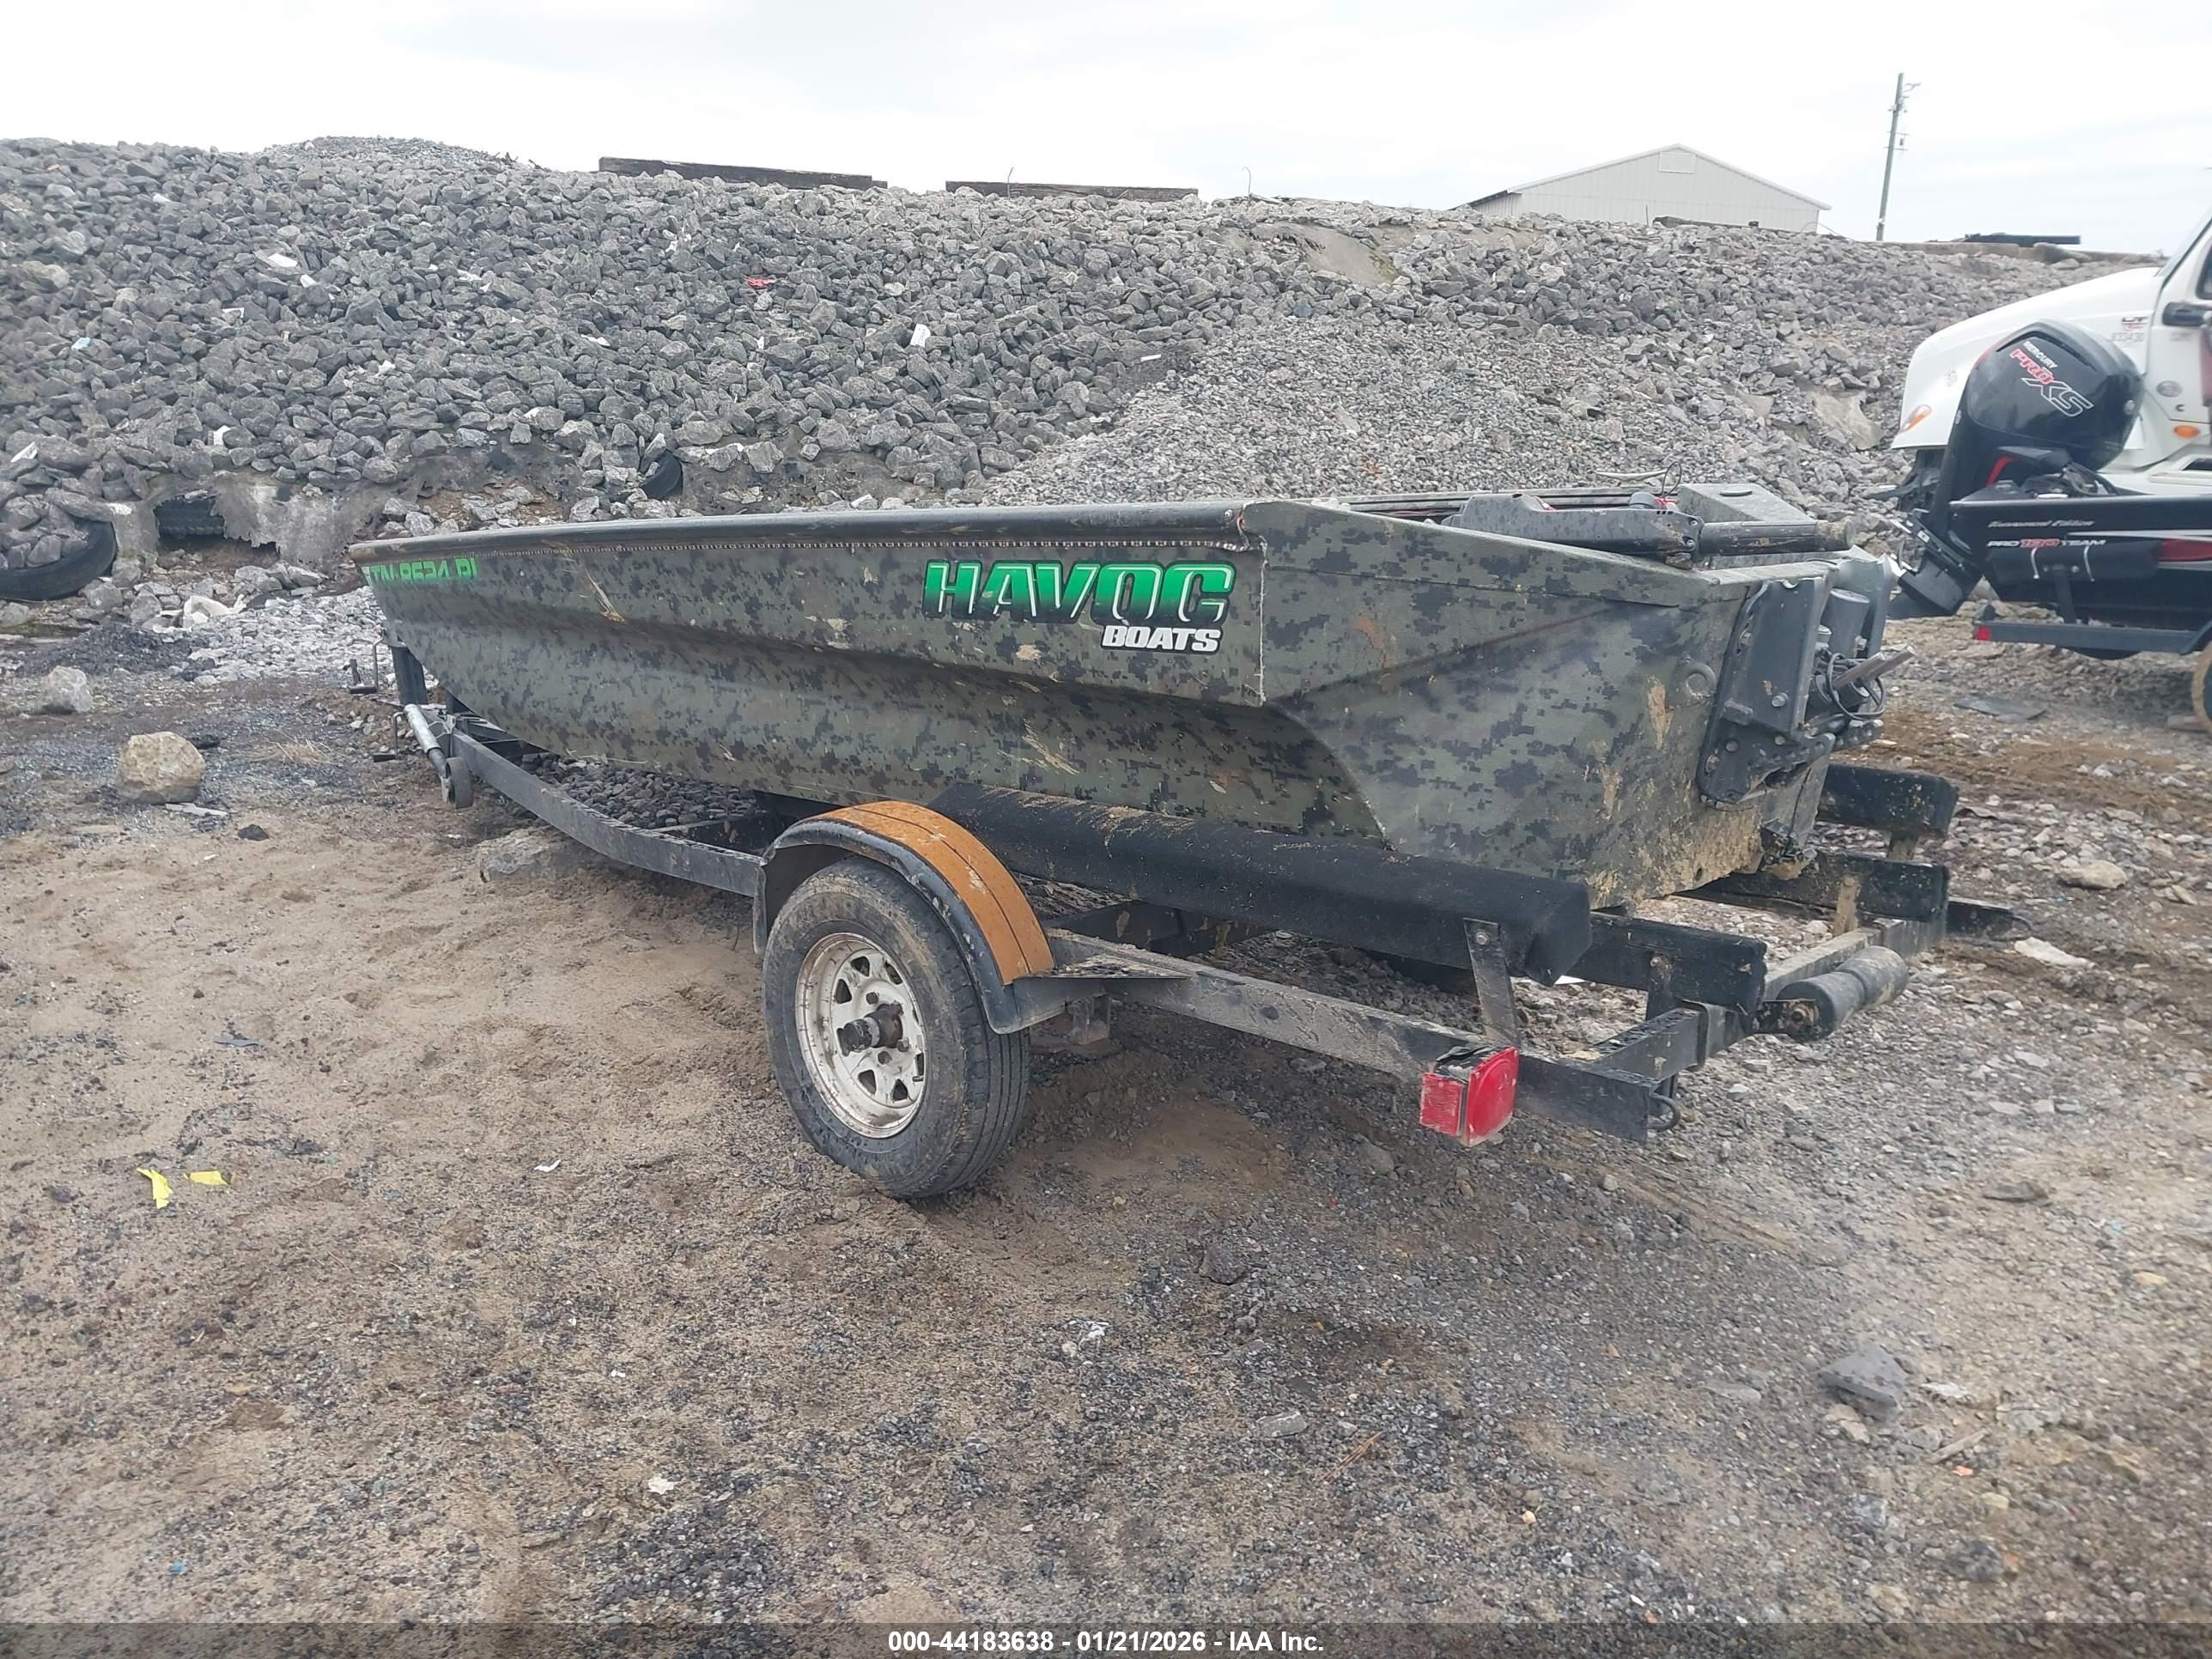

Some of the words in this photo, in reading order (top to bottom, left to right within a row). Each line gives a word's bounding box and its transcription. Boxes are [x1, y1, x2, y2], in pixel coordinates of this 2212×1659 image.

[2009, 348, 2055, 386] PRO
[2022, 340, 2058, 369] MERCURY
[2021, 377, 2095, 417] XS
[2061, 538, 2106, 547] TEAM
[922, 560, 1236, 624] HAVOC
[1101, 624, 1223, 653] BOATS
